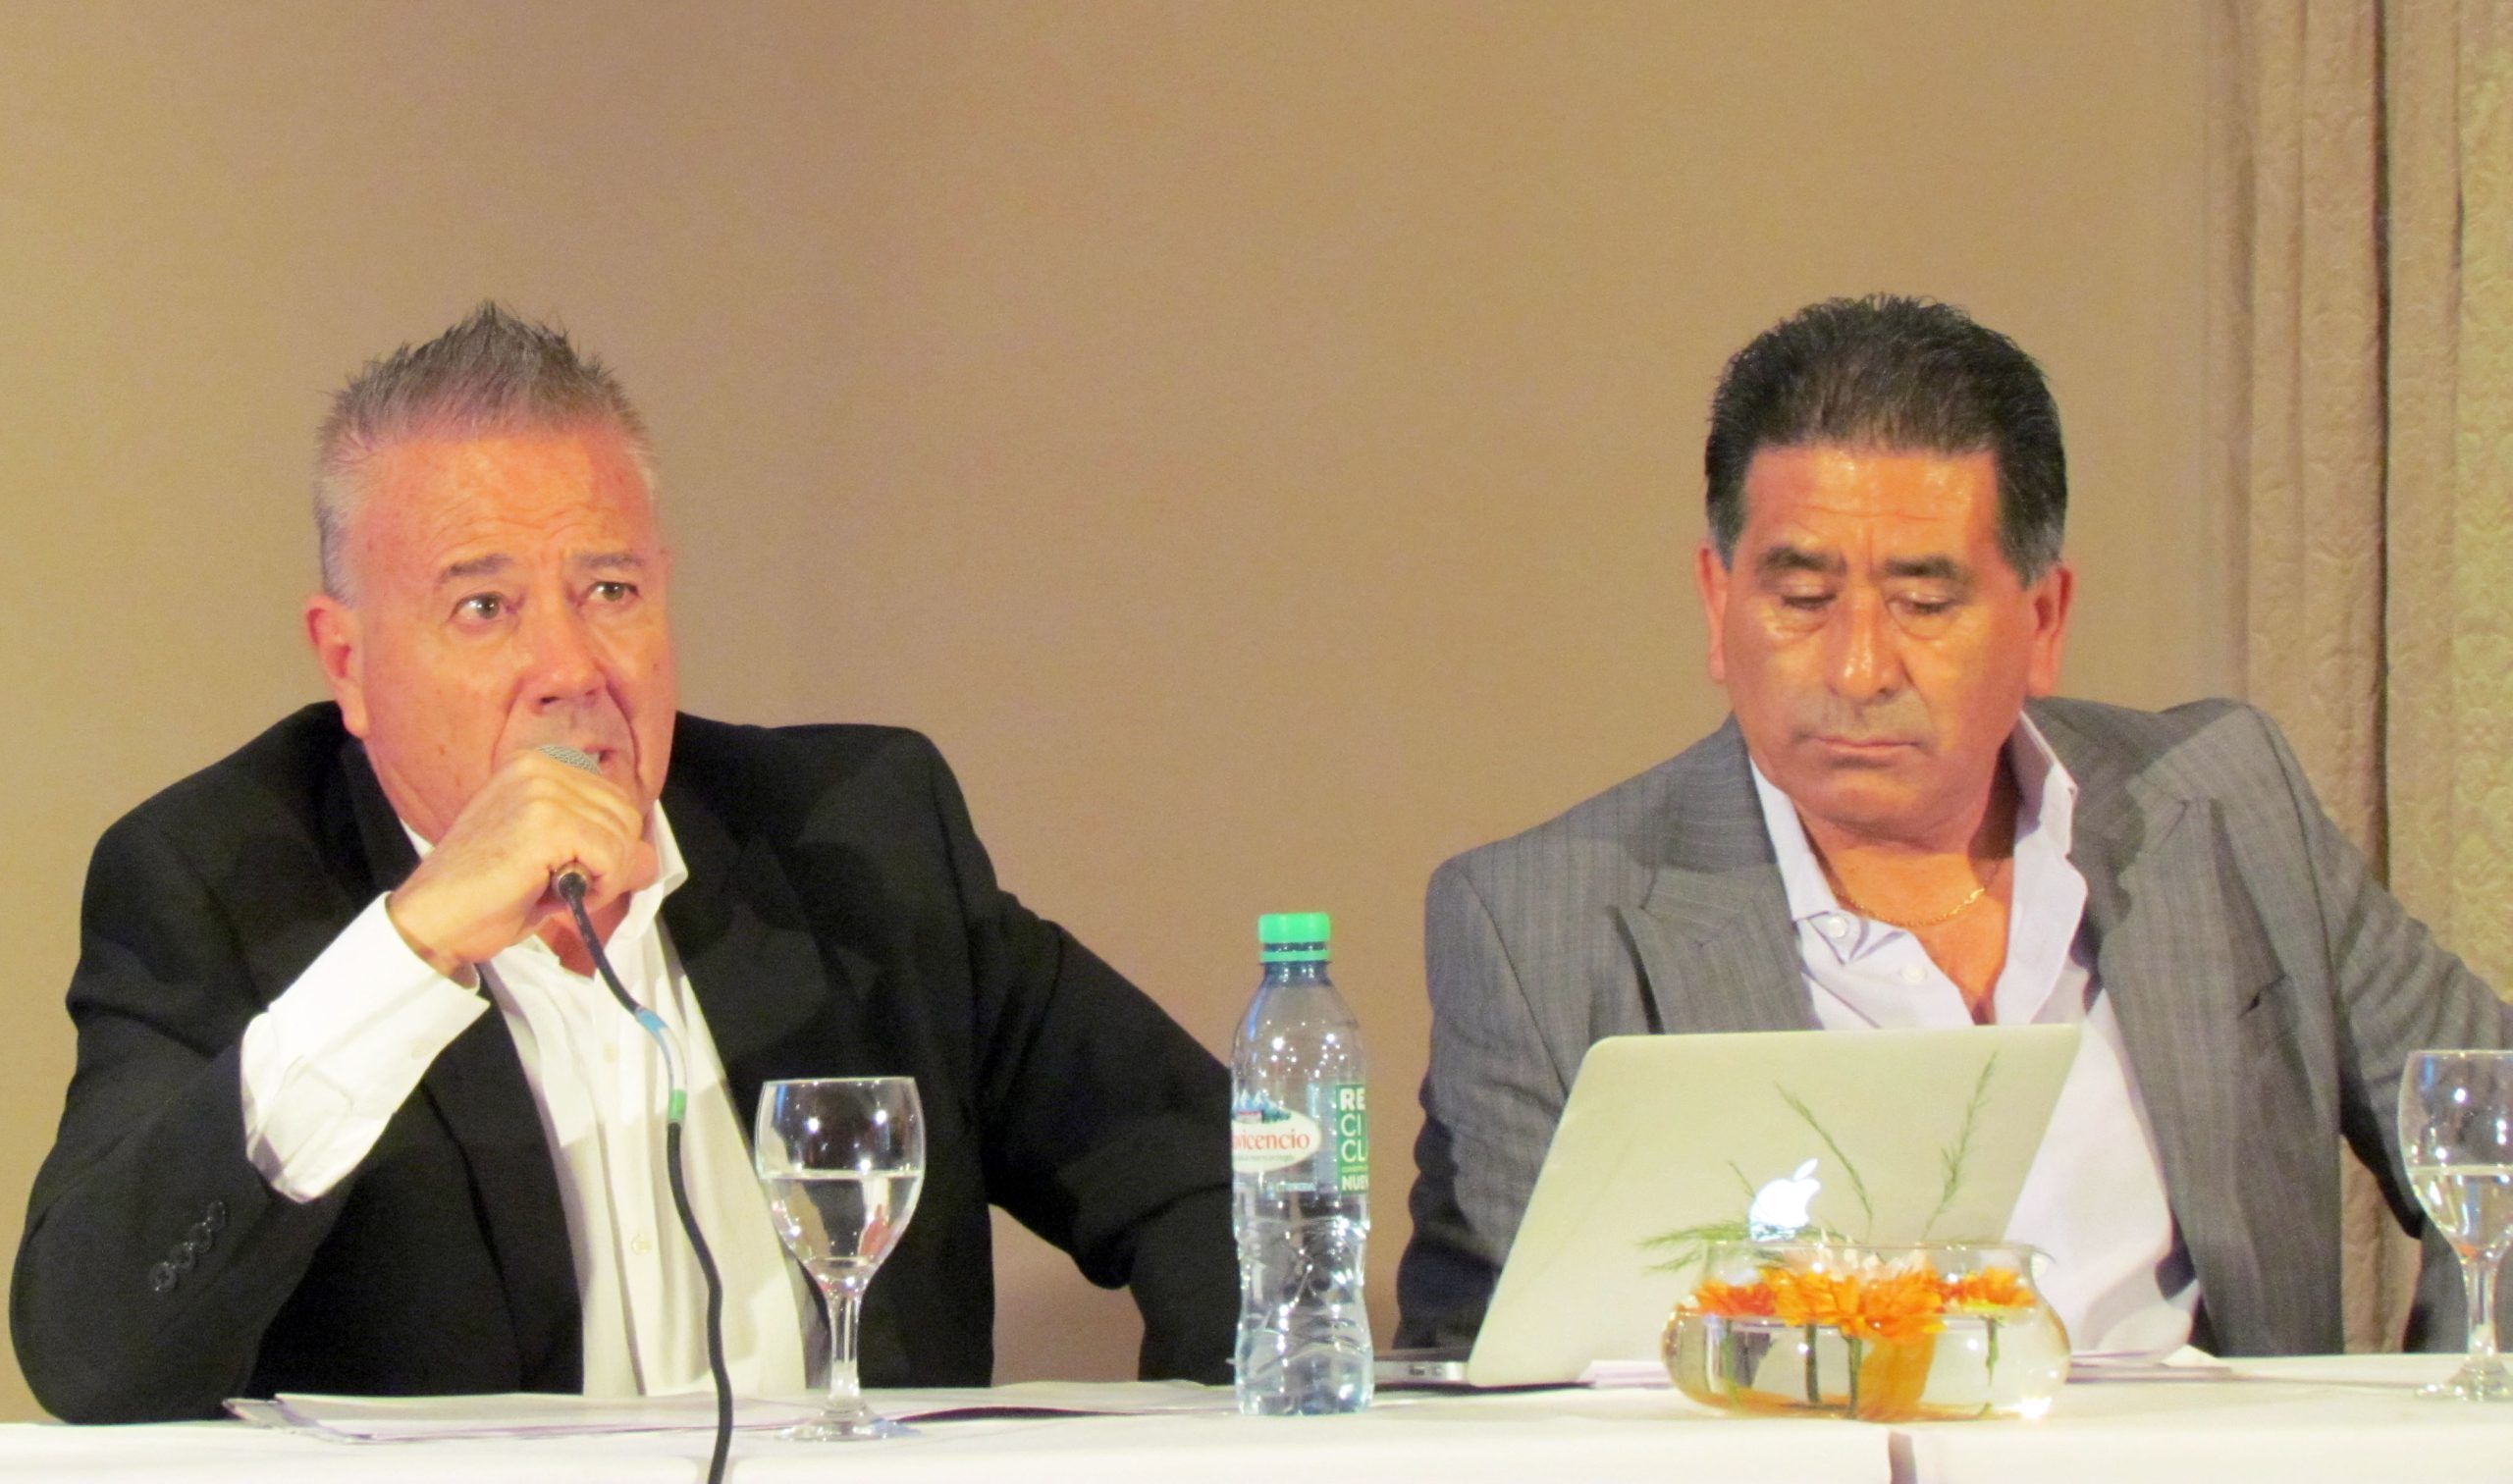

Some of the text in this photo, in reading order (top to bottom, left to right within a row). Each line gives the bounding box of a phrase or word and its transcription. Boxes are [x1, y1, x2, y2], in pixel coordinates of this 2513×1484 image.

[1339, 1087, 1366, 1111] RE
[1341, 1113, 1362, 1137] CI
[1341, 1140, 1369, 1162] CL
